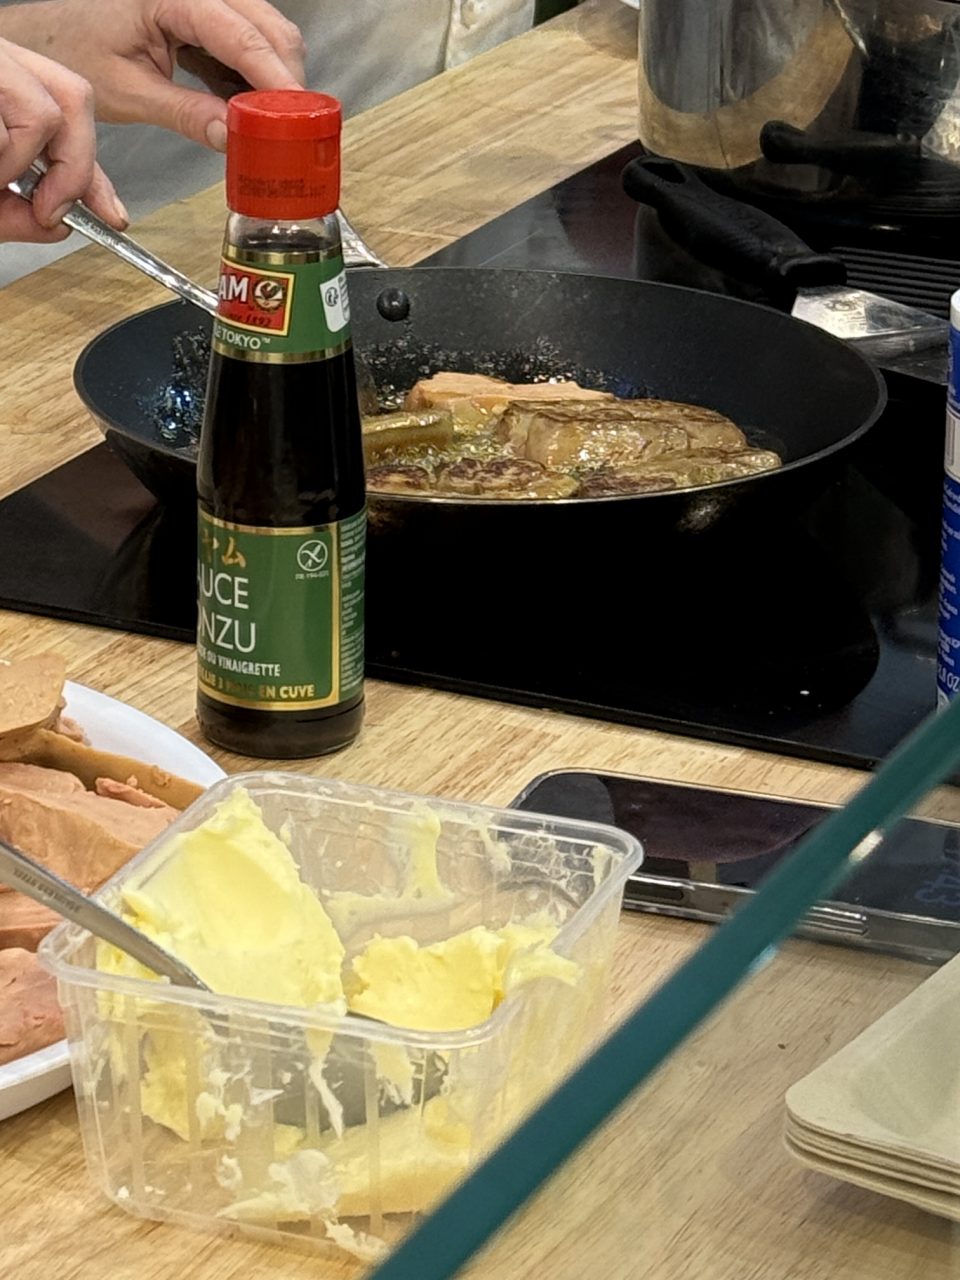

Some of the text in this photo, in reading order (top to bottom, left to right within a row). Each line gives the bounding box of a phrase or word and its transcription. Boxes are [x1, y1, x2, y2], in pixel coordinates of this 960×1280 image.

[217, 654, 281, 677] VINAIGRETTE
[258, 684, 276, 698] EN
[279, 684, 315, 699] CUVE
